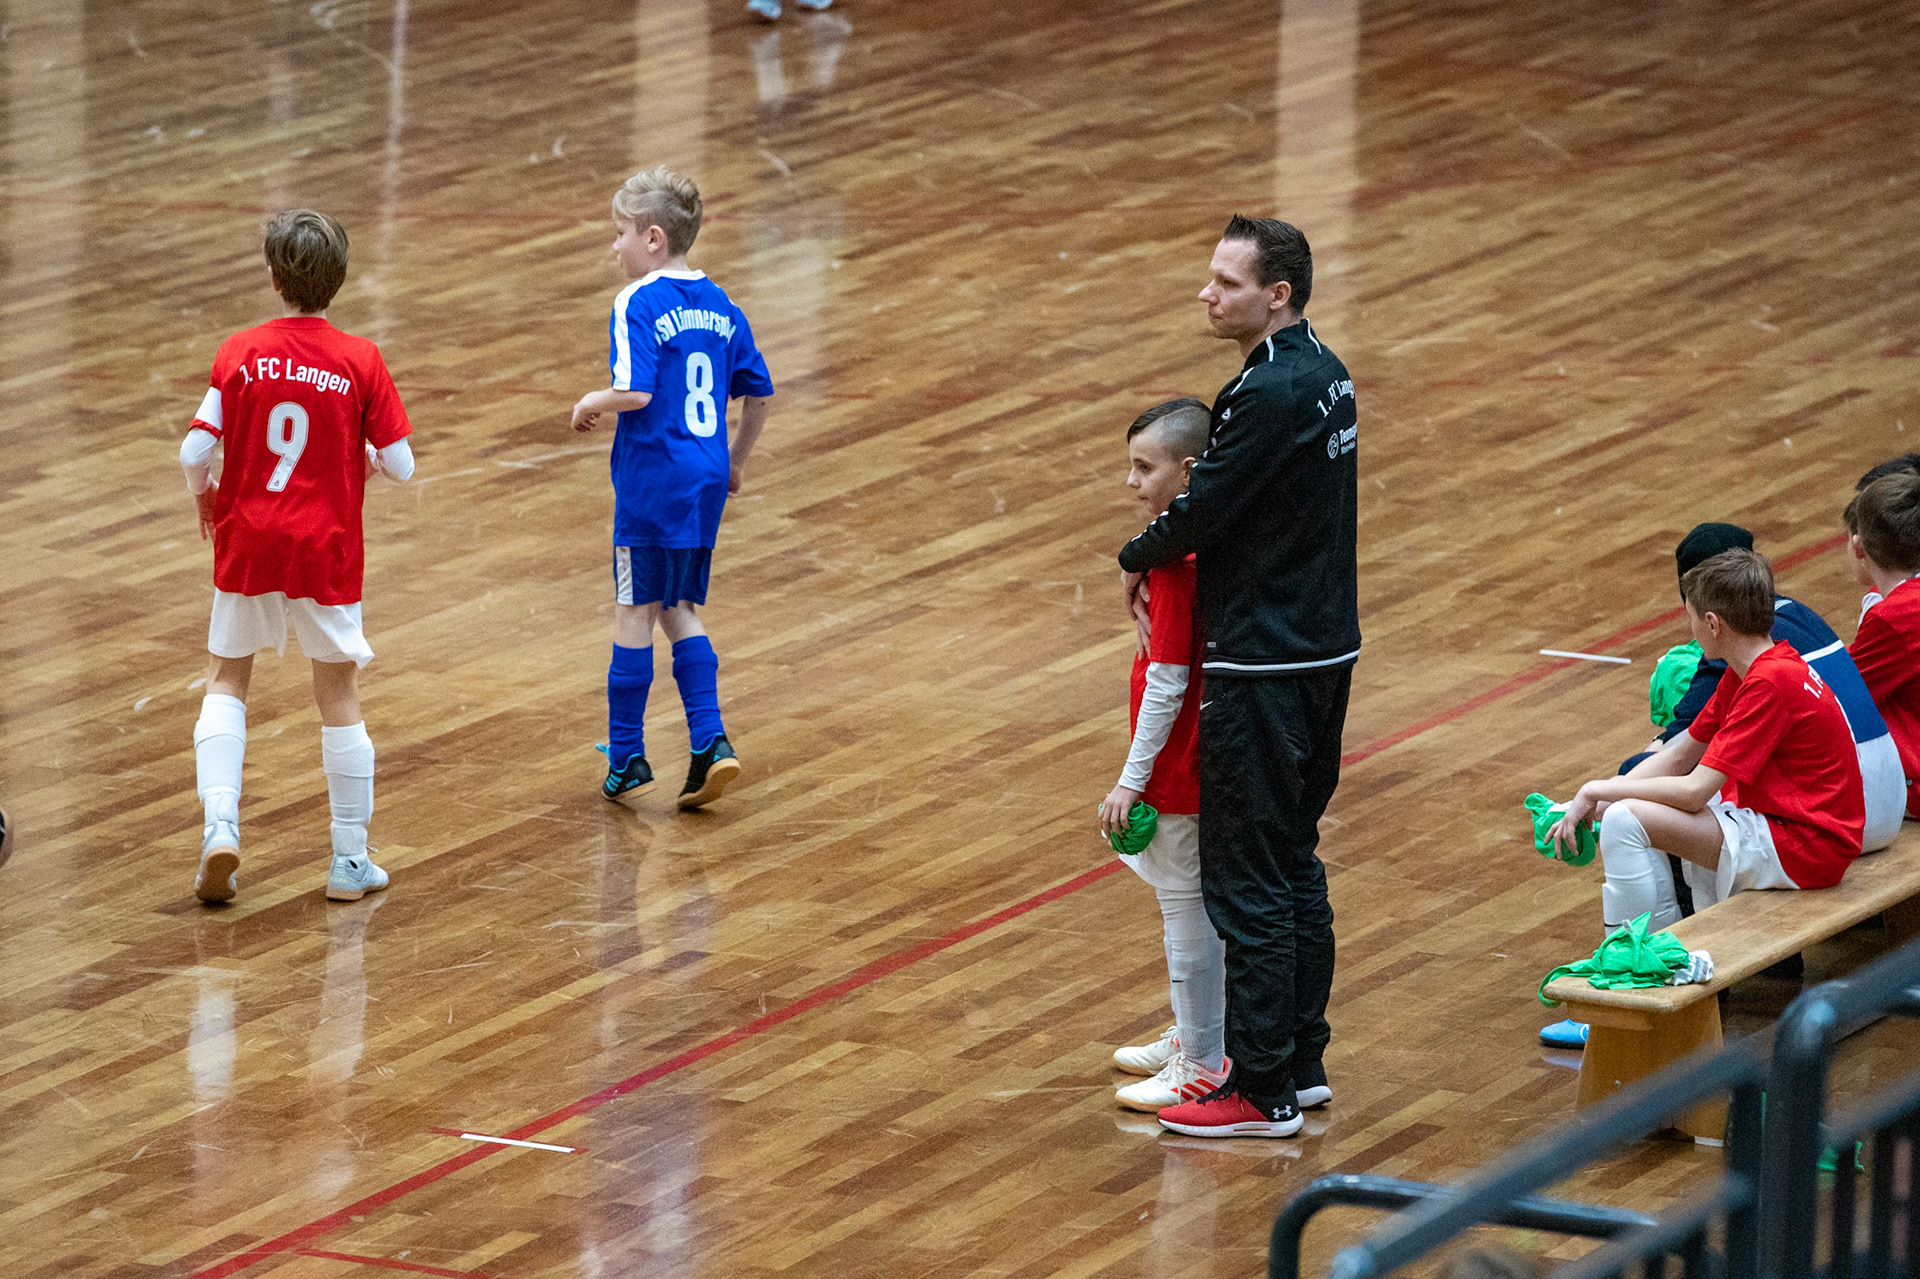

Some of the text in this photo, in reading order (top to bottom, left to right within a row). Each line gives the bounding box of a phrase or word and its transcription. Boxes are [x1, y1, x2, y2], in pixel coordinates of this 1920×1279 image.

[239, 357, 351, 395] 1. FC Langen
[684, 351, 718, 438] 8
[1316, 399, 1332, 418] 1.
[1334, 379, 1355, 399] Lang
[266, 401, 310, 492] 9
[1803, 681, 1822, 699] 1.
